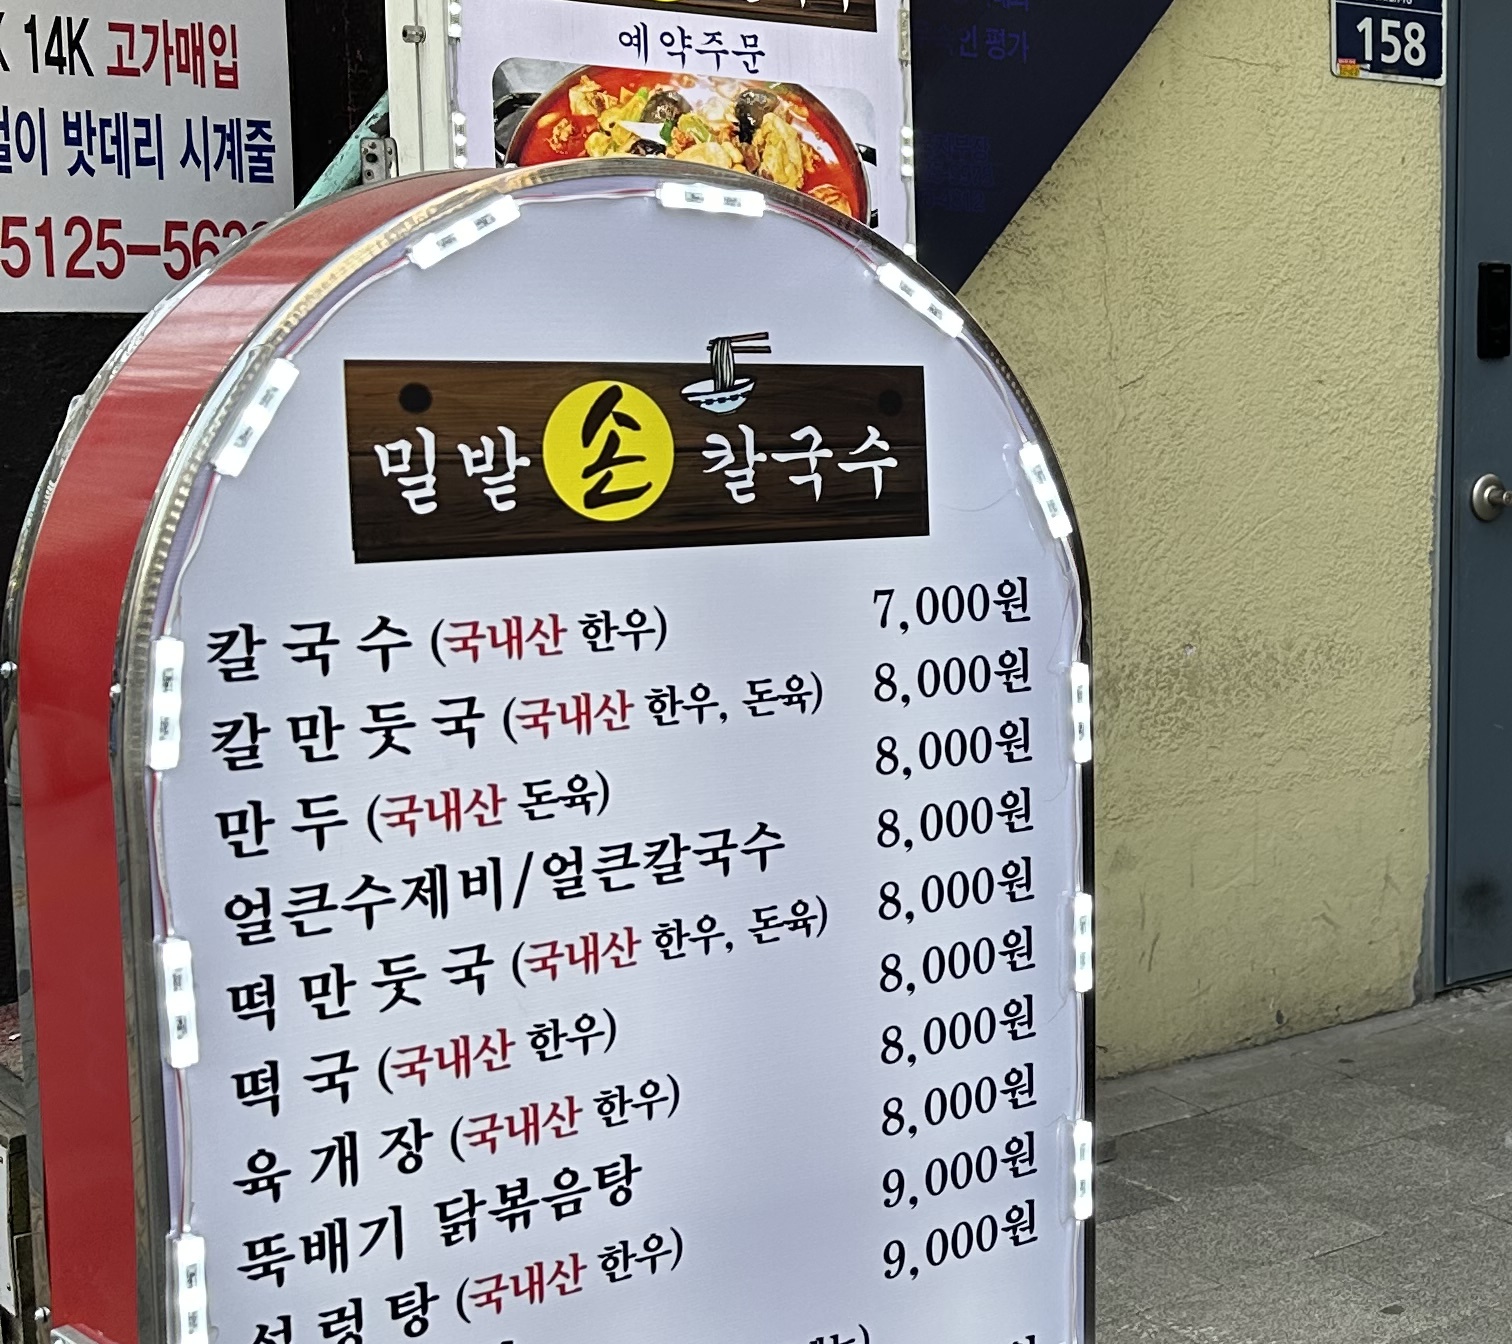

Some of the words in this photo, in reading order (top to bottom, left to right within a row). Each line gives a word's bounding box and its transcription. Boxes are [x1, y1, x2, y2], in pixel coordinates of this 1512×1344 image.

[24, 13, 95, 77] 14K
[107, 19, 240, 90] 고가매입
[1356, 16, 1427, 67] 158
[62, 109, 166, 181] 밧데리
[179, 114, 276, 185] 시계줄
[702, 424, 899, 505] 칼국수
[430, 612, 569, 668] (국내산
[578, 605, 668, 654] 한우)
[871, 575, 1032, 635] 7,000원
[503, 688, 636, 745] (국내산
[645, 681, 728, 728] 한우,
[742, 670, 824, 718] 돈육)
[873, 646, 1033, 707] 8,000원
[366, 782, 508, 843] (국내산
[517, 769, 610, 821] 돈육)
[874, 716, 1034, 780] 8,000원
[876, 786, 1035, 853] 8,000원
[512, 926, 642, 988] (국내산
[651, 913, 734, 961] 한우,
[748, 895, 828, 945] 돈육)
[878, 856, 1035, 925] 8,000원
[378, 1027, 516, 1095] (국내산
[527, 1008, 618, 1063] 한우)
[879, 924, 1036, 994] 8,000원
[450, 1094, 584, 1163] (국내산
[592, 1073, 681, 1128] 한우)
[880, 993, 1037, 1068] 8,000원
[237, 1204, 404, 1289] 뚝배기
[433, 1153, 643, 1248] 닭볶음탕
[881, 1062, 1038, 1138] 8,000원
[456, 1252, 588, 1325] (국내산
[597, 1226, 684, 1284] 한우)
[881, 1130, 1038, 1210] 9,000원
[882, 1198, 1039, 1281] 9,000원
